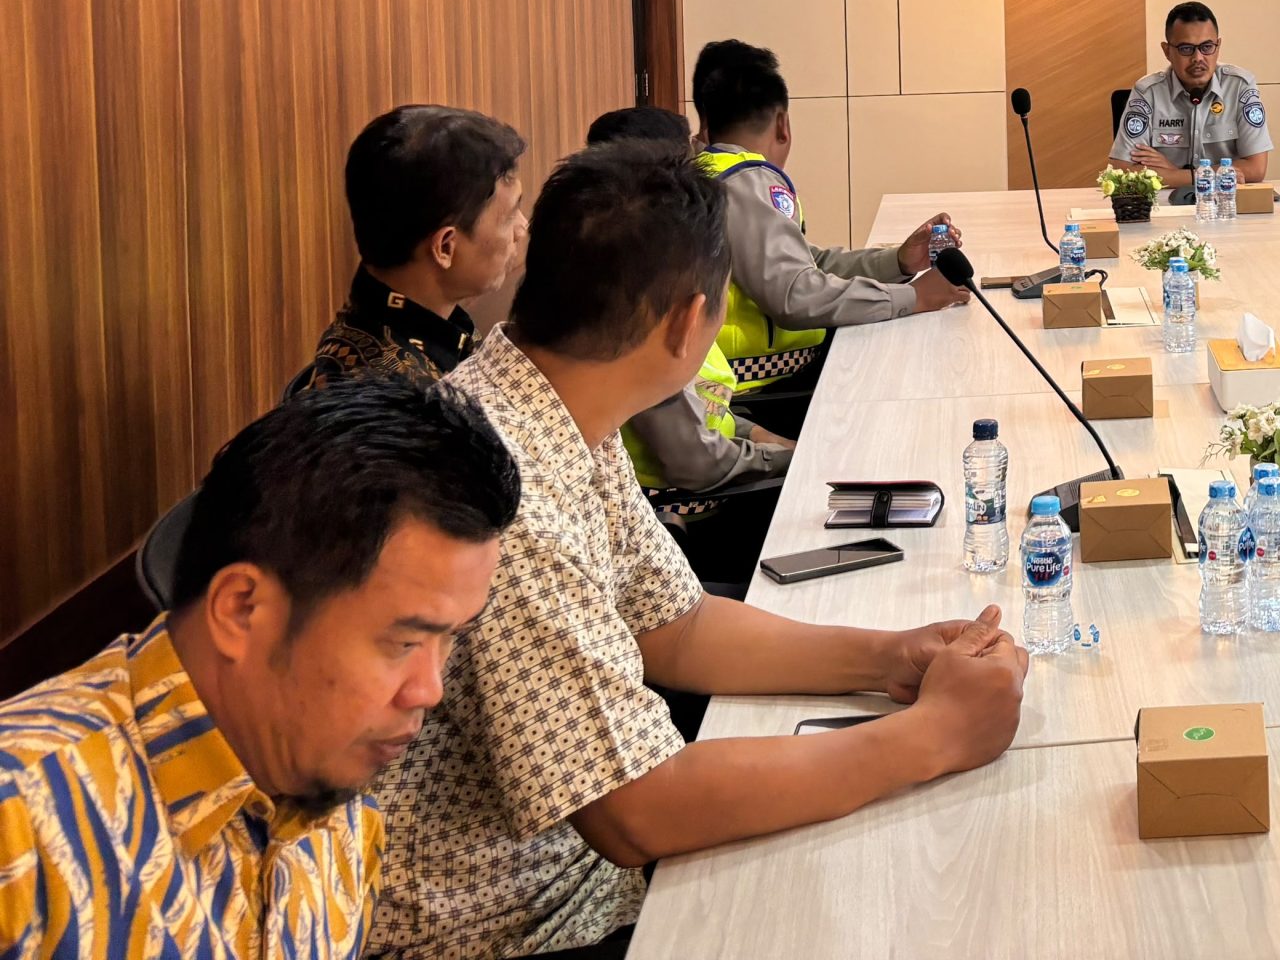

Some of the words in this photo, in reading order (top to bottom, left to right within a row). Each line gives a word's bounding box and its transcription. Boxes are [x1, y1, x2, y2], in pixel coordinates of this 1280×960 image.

[1159, 118, 1185, 128] HARRY
[1026, 562, 1045, 573] Pure
[1045, 562, 1061, 575] Life
